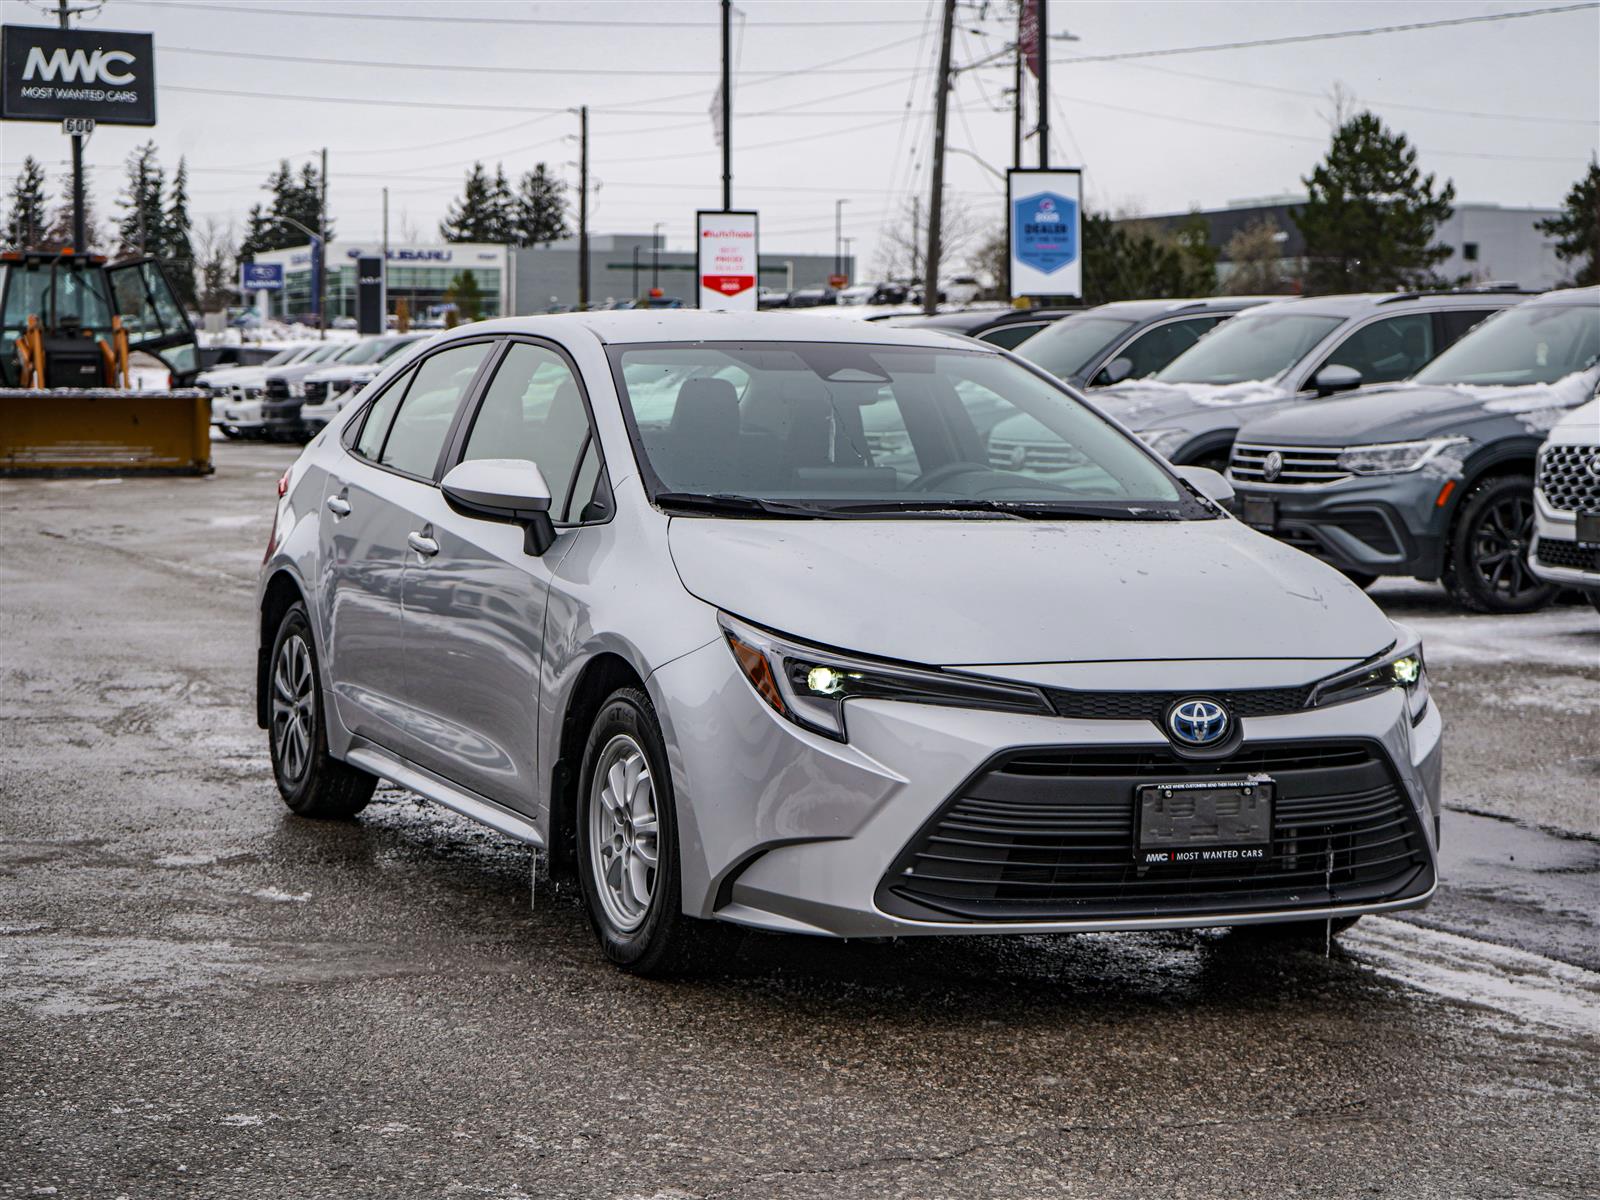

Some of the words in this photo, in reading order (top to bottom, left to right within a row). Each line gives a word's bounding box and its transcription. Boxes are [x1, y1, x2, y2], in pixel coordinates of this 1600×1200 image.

[22, 46, 137, 86] MWC
[21, 87, 54, 98] MOST
[55, 88, 105, 101] WANTED
[106, 91, 137, 103] CARS
[66, 119, 94, 132] 600
[1146, 853, 1168, 862] MWC
[1176, 852, 1199, 861] MOST
[1203, 850, 1239, 859] WANTED
[1241, 849, 1263, 858] CARS
